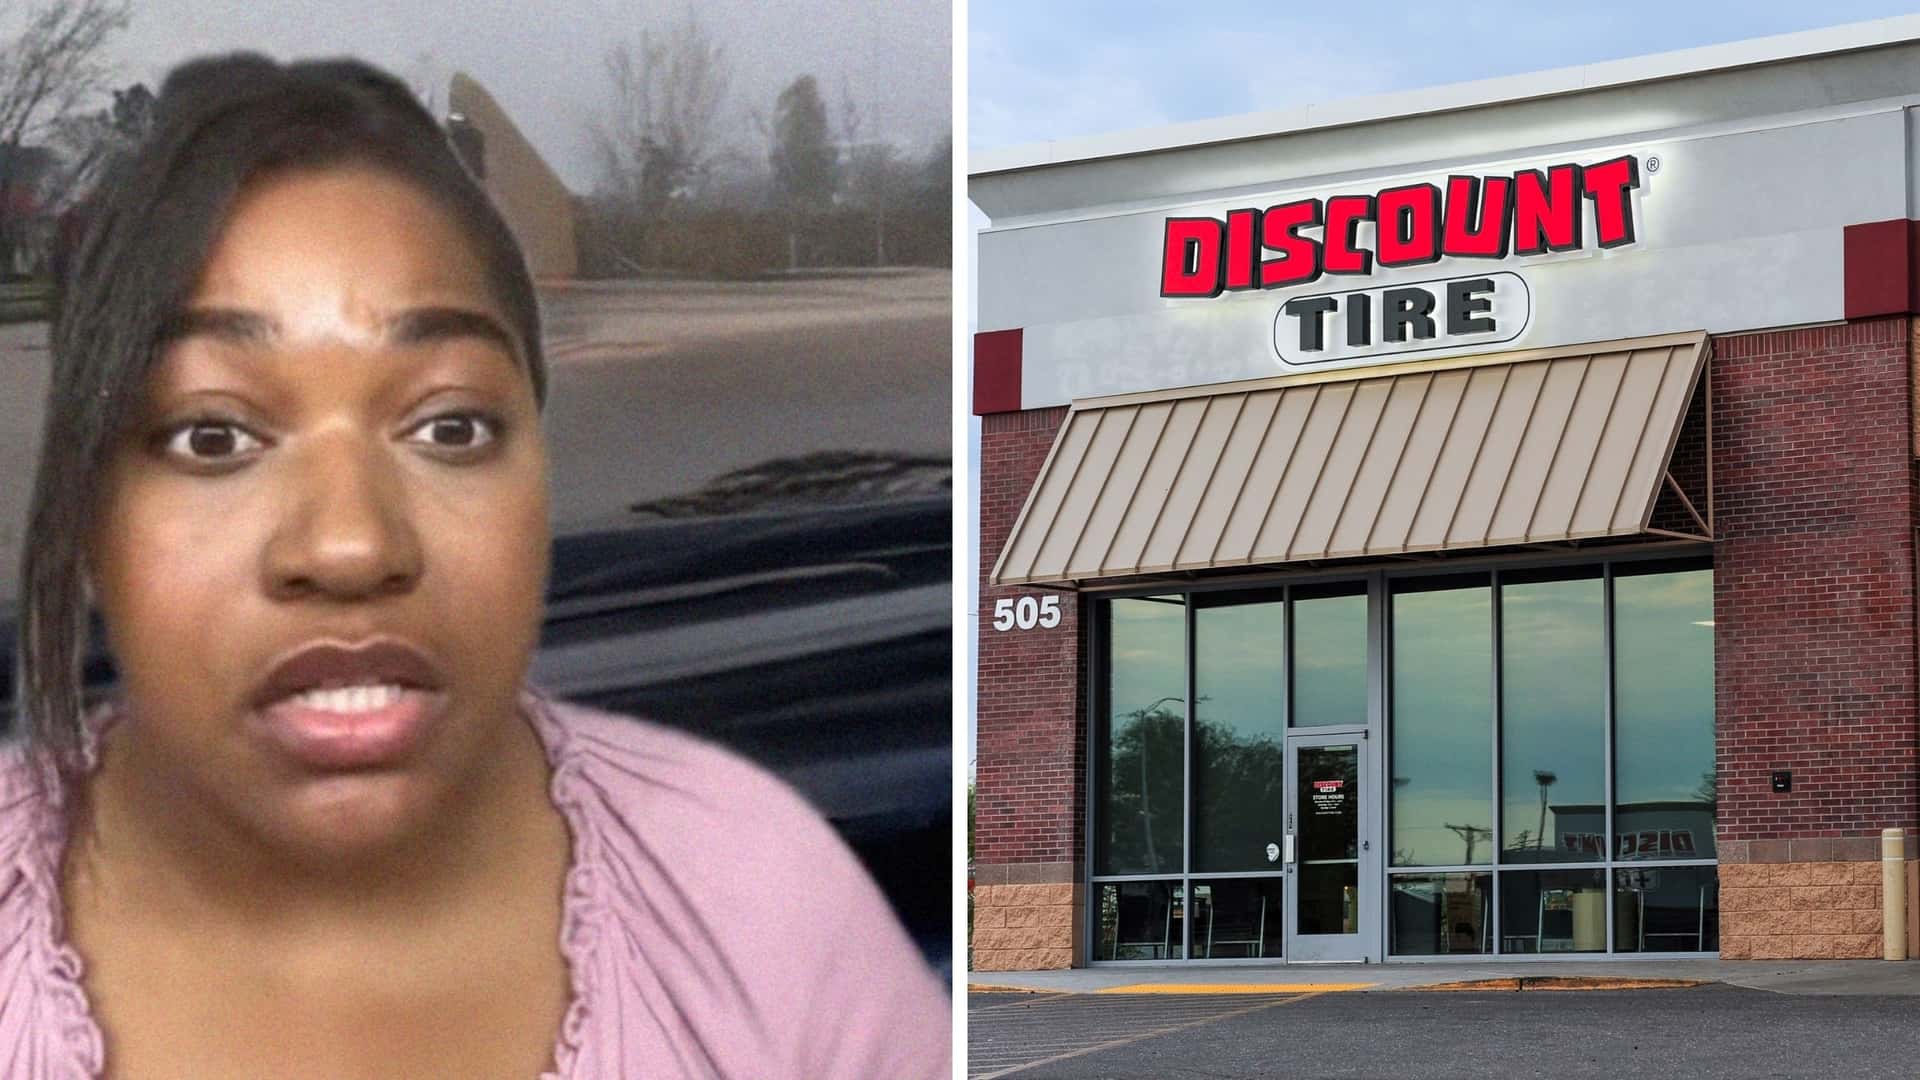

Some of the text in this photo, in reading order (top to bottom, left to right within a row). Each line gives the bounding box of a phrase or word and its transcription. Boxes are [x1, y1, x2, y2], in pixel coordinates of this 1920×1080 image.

[1160, 155, 1640, 298] DISCOUNT
[1285, 278, 1496, 352] TIRE
[992, 595, 1061, 632] 505
